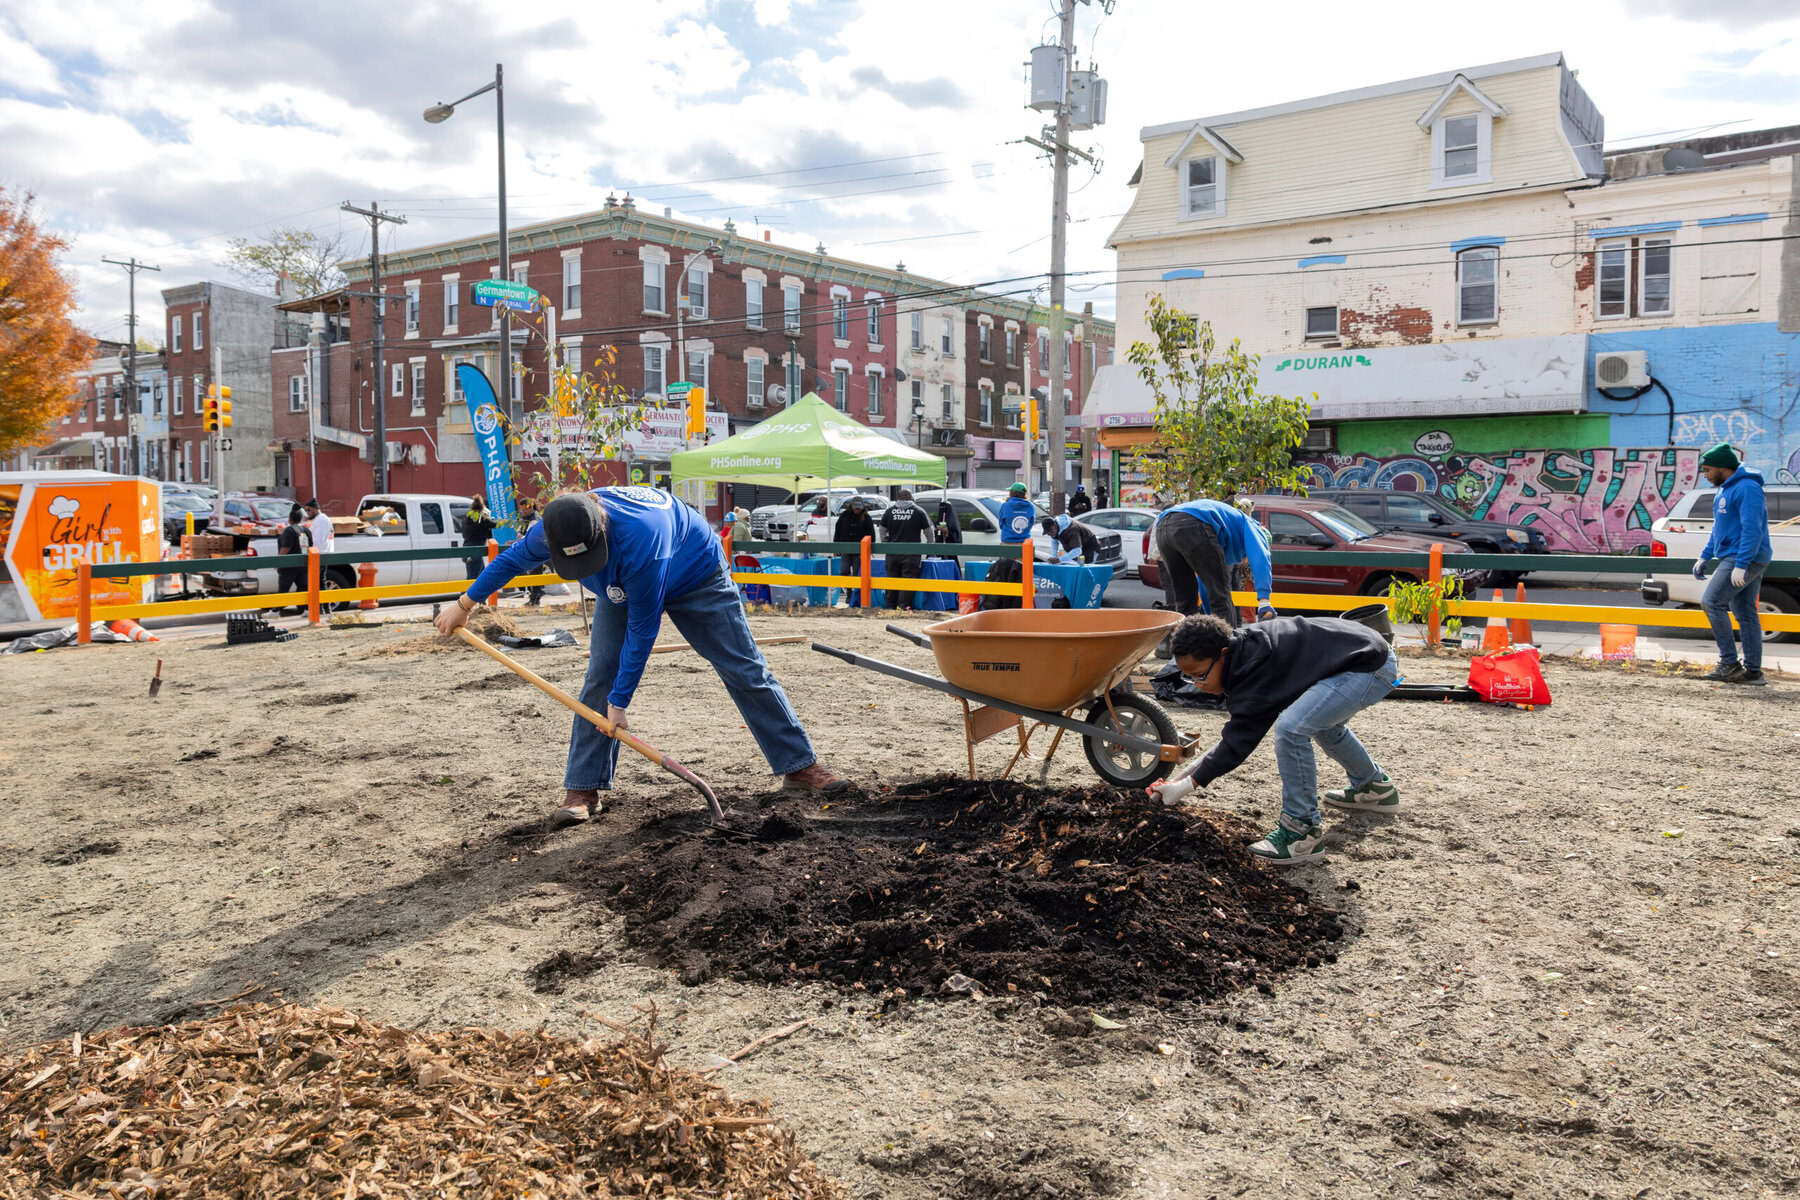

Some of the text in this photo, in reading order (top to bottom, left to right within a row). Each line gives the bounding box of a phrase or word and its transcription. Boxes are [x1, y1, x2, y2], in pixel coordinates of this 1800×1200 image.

[477, 284, 526, 299] Germantown
[1293, 355, 1353, 371] DURAN
[767, 423, 812, 435] PHS
[484, 435, 501, 482] PHS
[710, 455, 782, 469] PHSonline.org
[863, 457, 917, 475] PHSonline.org
[891, 508, 915, 516] ODAAT
[50, 503, 112, 544] Girl
[103, 527, 122, 535] with
[43, 540, 133, 572] GRILL
[972, 662, 1021, 672] TRUE TEMPER
